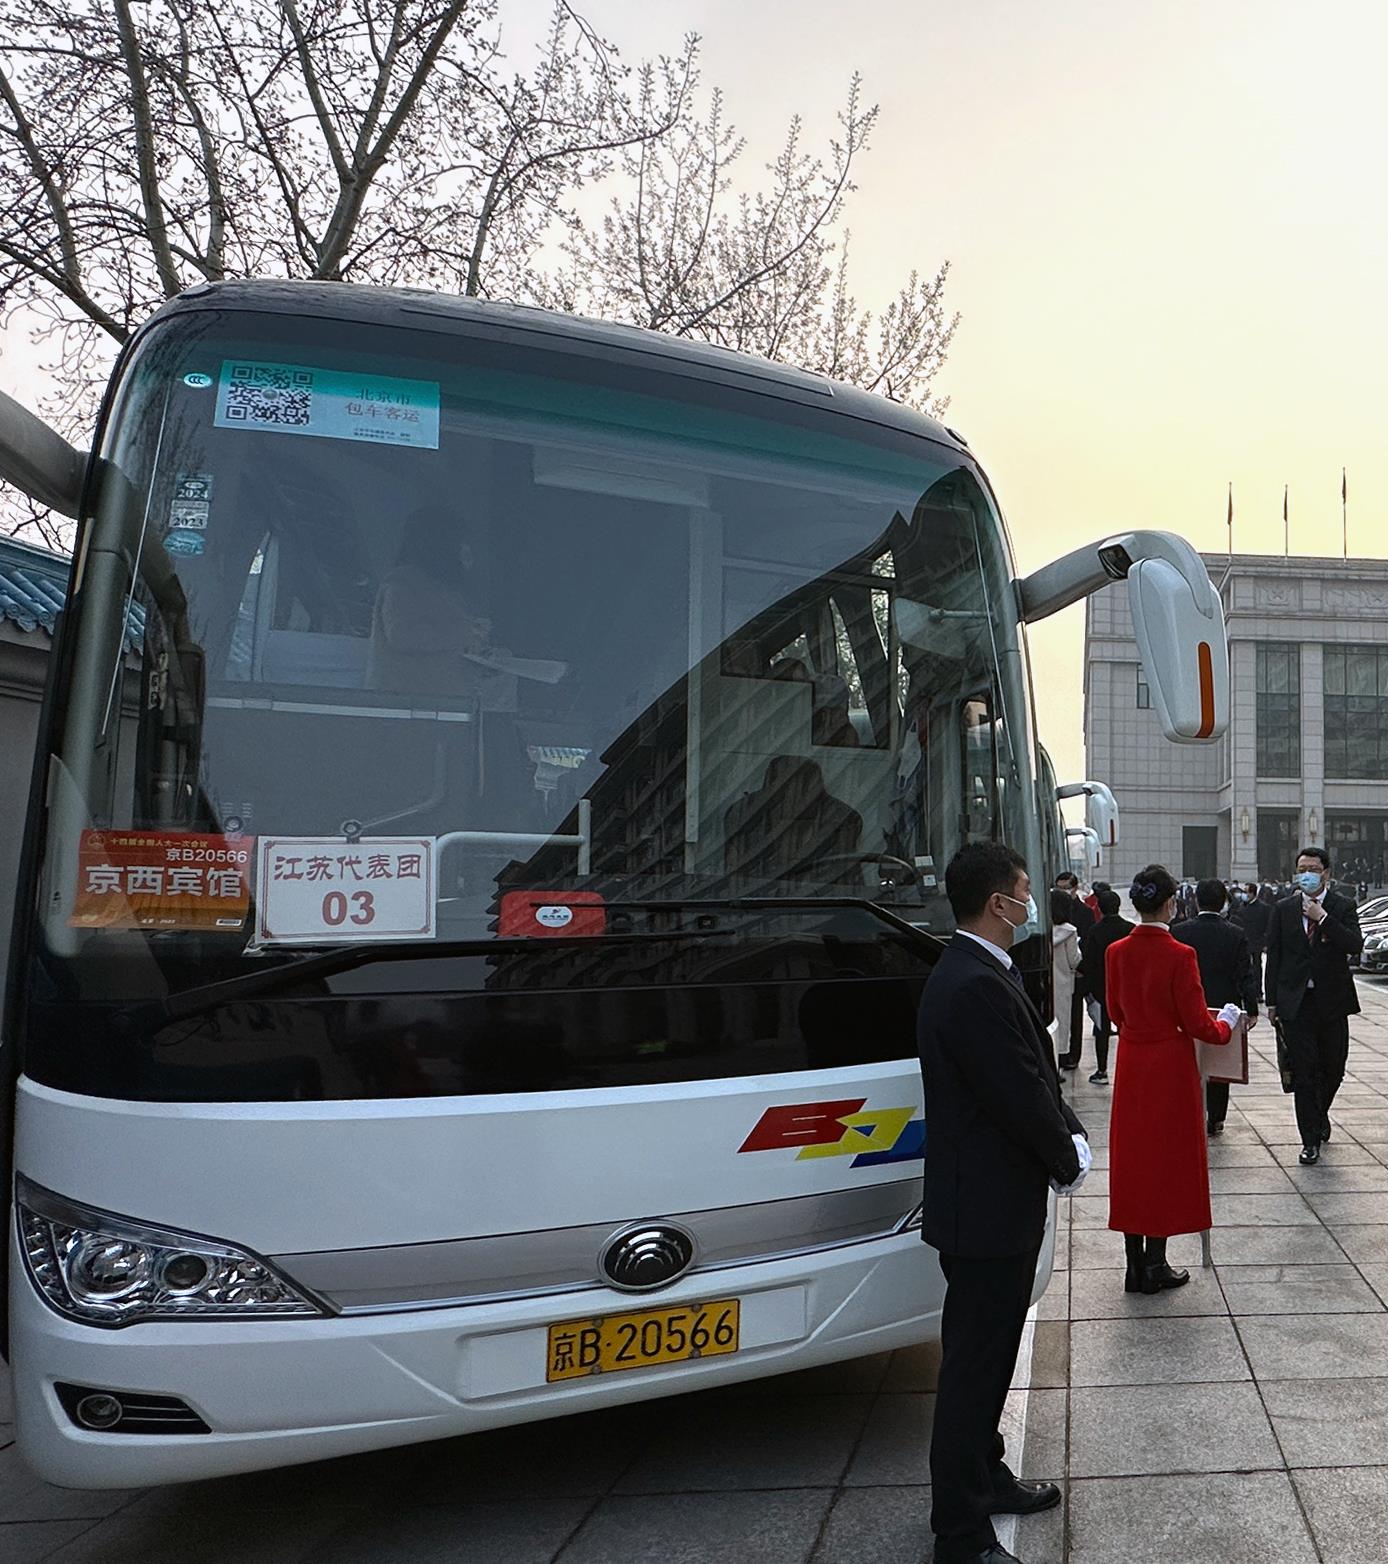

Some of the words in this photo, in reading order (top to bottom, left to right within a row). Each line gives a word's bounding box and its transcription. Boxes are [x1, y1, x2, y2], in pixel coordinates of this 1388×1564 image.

[356, 388, 411, 406] 北京市
[345, 402, 420, 423] 包车客运
[177, 489, 209, 499] 2024
[173, 517, 204, 527] 2023
[166, 848, 248, 864] 京B20566
[274, 853, 423, 881] 江苏代表团
[85, 863, 243, 898] 京西宾馆
[321, 890, 375, 926] 03
